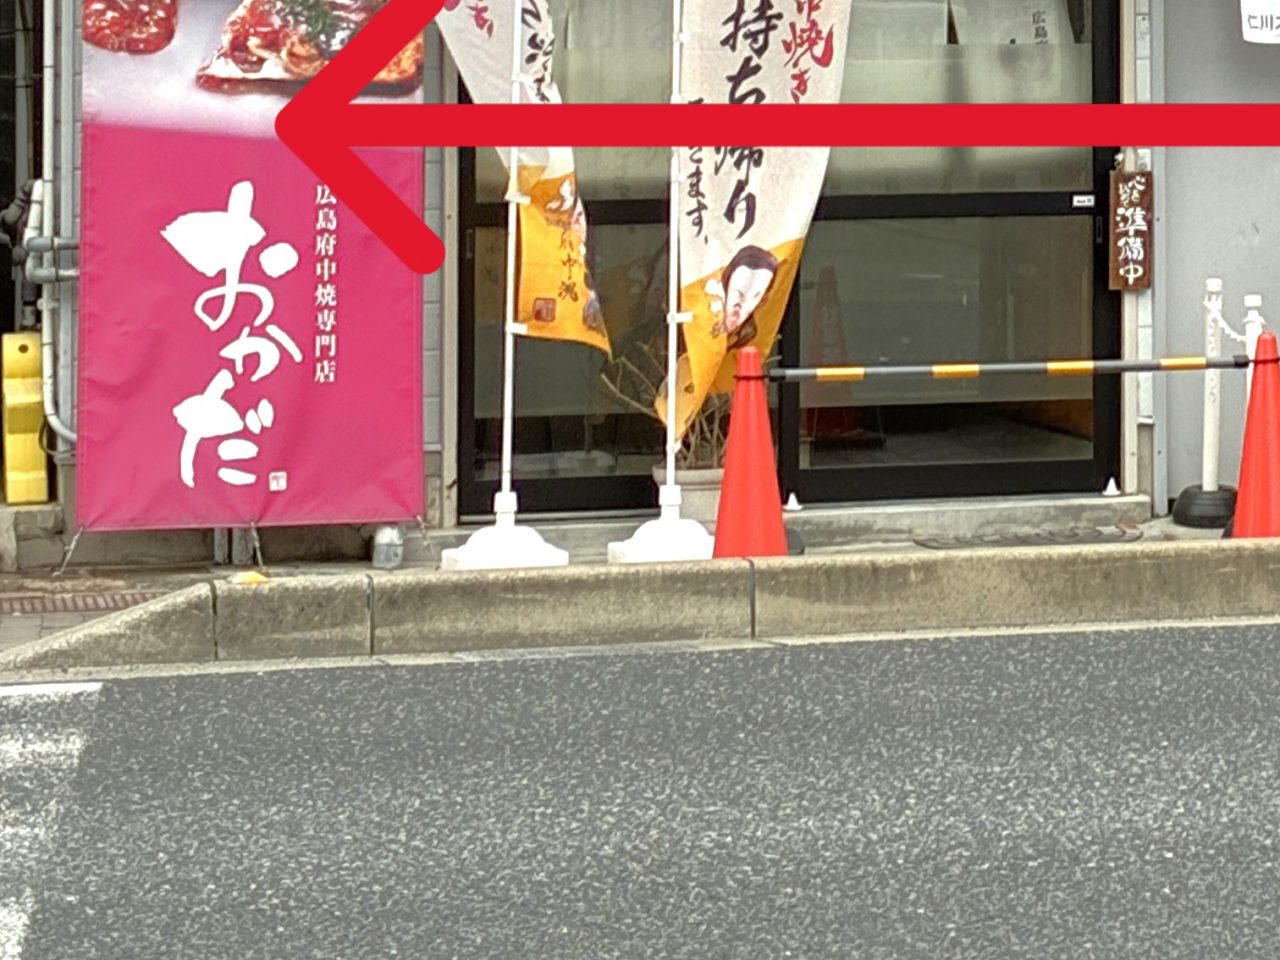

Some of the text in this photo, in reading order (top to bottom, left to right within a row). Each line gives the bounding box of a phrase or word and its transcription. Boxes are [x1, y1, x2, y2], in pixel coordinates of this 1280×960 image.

[159, 180, 303, 488] おかだ
[314, 184, 337, 383] 広島府中焼専門店
[1115, 206, 1148, 285] 準備中
